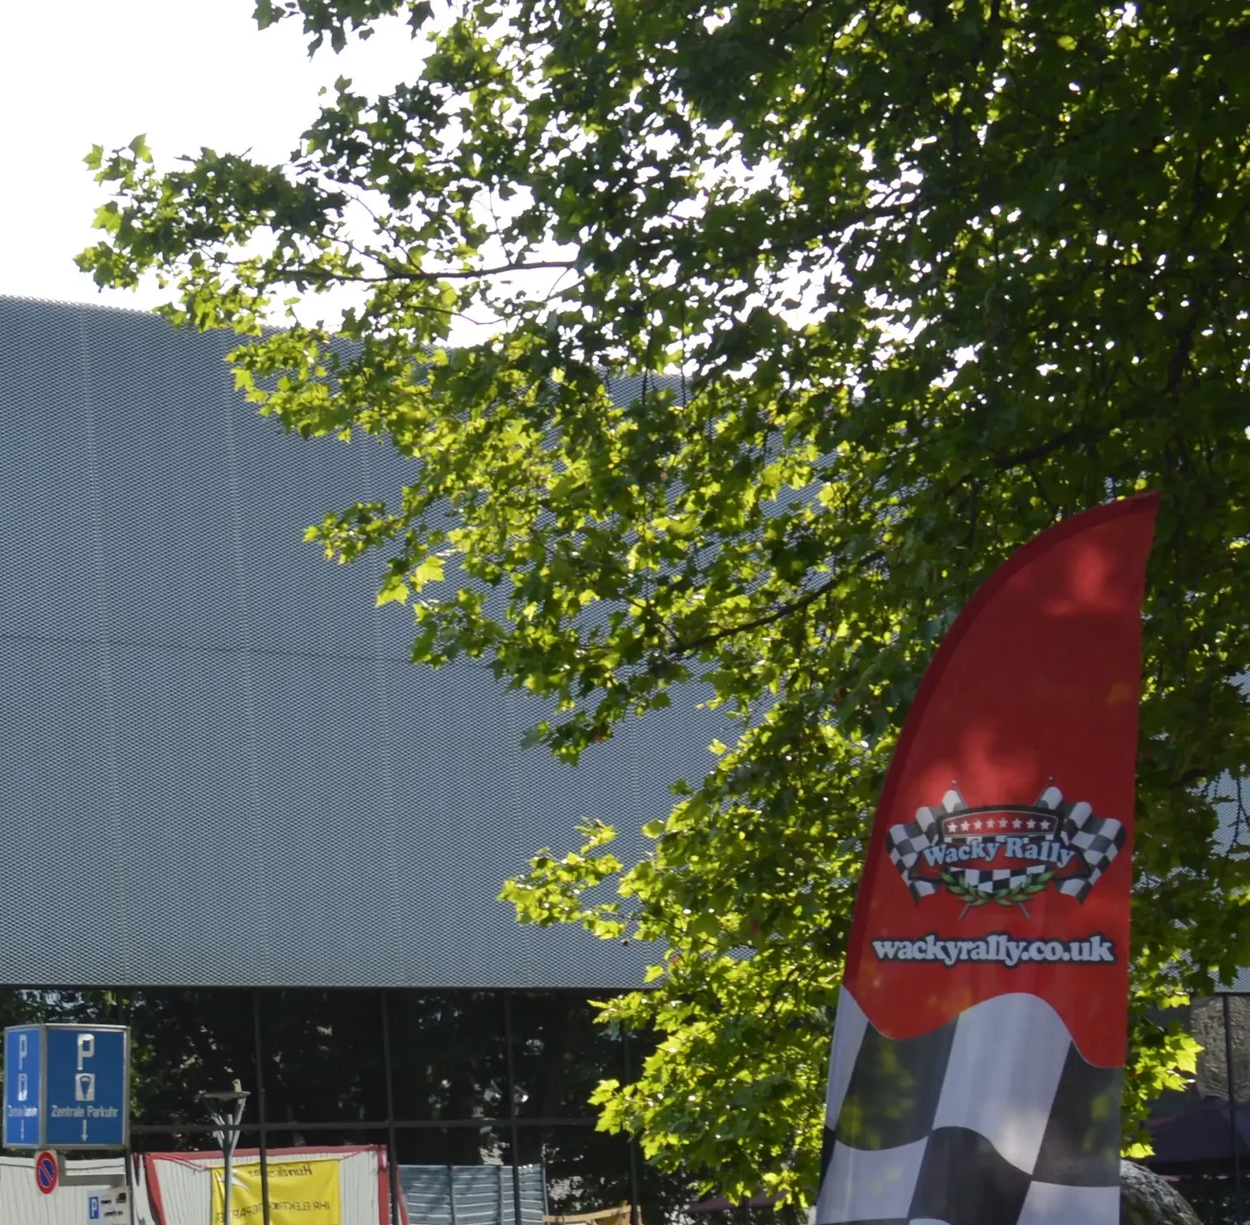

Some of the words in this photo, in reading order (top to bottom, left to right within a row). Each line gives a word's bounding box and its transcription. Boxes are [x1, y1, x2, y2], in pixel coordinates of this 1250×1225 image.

[924, 838, 999, 866] Wacky
[1005, 837, 1075, 867] Rally
[872, 934, 1114, 966] wackyrally.co.uk
[77, 1033, 95, 1071] P
[51, 1105, 84, 1117] Zentrale
[87, 1105, 118, 1117] Parkuhr
